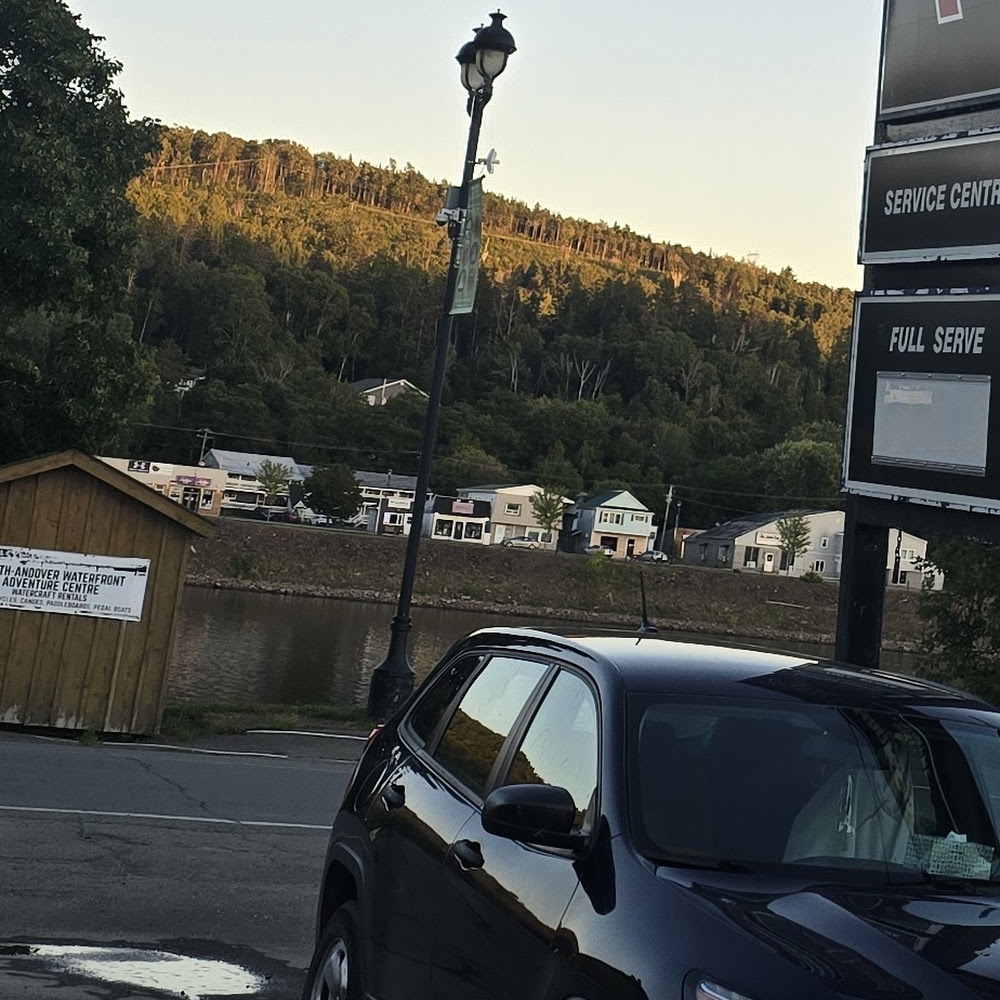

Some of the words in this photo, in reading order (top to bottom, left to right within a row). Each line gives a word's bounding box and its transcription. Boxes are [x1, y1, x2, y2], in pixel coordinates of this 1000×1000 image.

[884, 184, 947, 215] SERVICE
[889, 325, 925, 353] FULL
[933, 326, 985, 354] SERVE
[2, 576, 60, 591] ADVENTURE
[62, 582, 100, 595] CENTRE
[63, 571, 126, 586] WATERFRONT
[12, 588, 56, 599] WATERCRAFT
[58, 591, 88, 602] RENTALS
